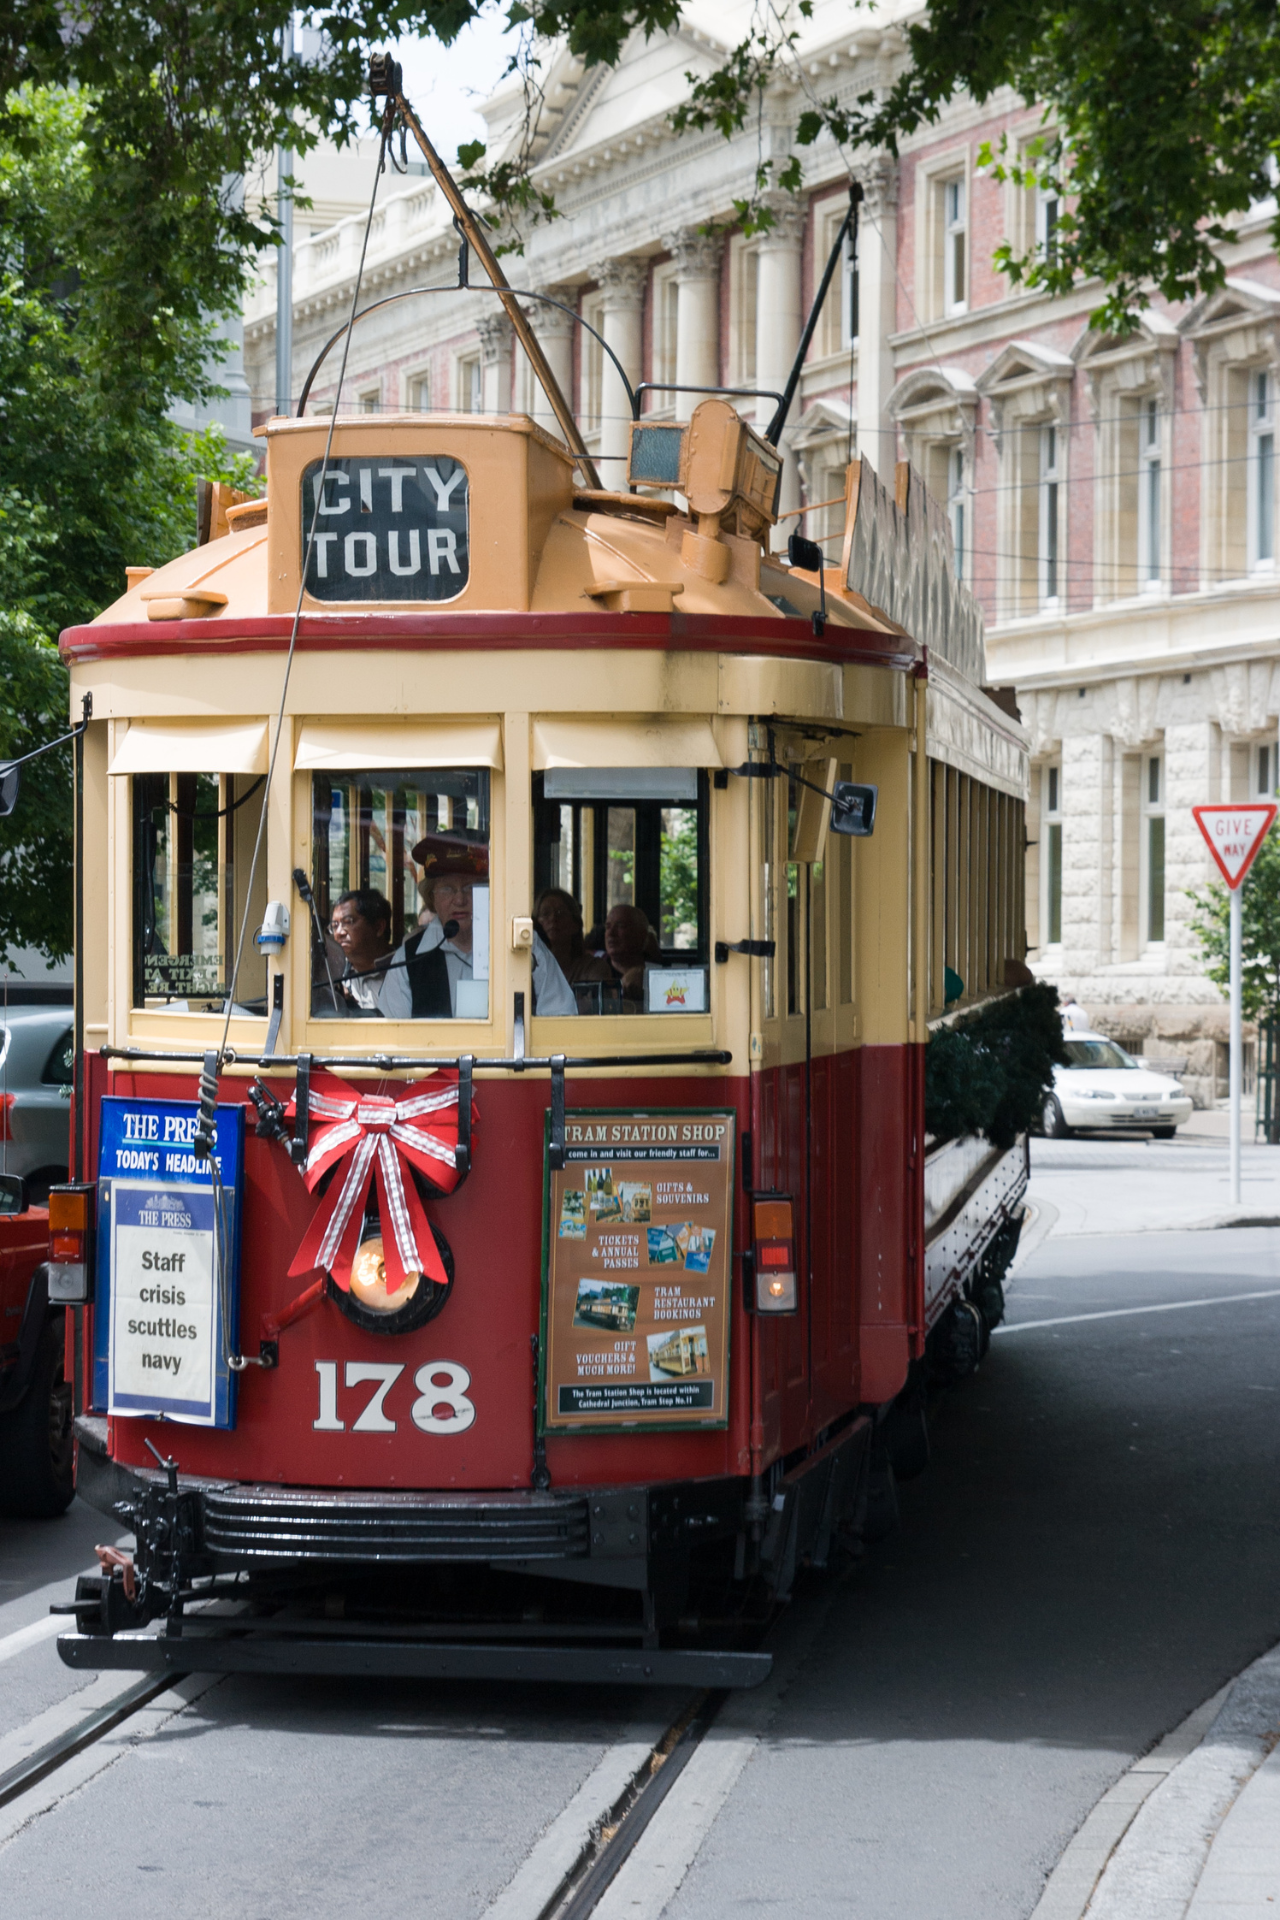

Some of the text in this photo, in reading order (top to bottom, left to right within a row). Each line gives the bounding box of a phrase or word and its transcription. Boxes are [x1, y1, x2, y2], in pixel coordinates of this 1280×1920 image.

[313, 467, 466, 515] CITY
[307, 528, 461, 578] TOUR
[1215, 818, 1252, 836] GIVE
[1223, 843, 1246, 857] WAY
[123, 1113, 218, 1147] THE PRE
[565, 1124, 725, 1142] TRAM STATION SHOP
[115, 1149, 159, 1172] TODAY'S
[568, 1150, 588, 1158] come
[590, 1148, 598, 1158] in
[599, 1149, 614, 1158] and
[616, 1148, 632, 1158] visit
[634, 1150, 647, 1158] our
[649, 1148, 677, 1160] friendly
[679, 1148, 696, 1157] staff
[656, 1182, 693, 1193] GIFTS &
[656, 1193, 710, 1204] SOUVENIRS
[138, 1210, 192, 1228] THE PRESS
[598, 1235, 640, 1246] TICKETS
[591, 1247, 639, 1258] & ANNUAL
[142, 1251, 185, 1272] Staff
[603, 1258, 639, 1269] PASSES
[140, 1284, 186, 1305] crisis
[654, 1286, 681, 1297] TRAM
[654, 1297, 715, 1309] RESTAURANT
[653, 1308, 702, 1321] BOOKINGS
[128, 1317, 197, 1339] scuttles
[614, 1341, 636, 1352] GIFT
[142, 1353, 182, 1375] navy
[576, 1352, 636, 1365] VOUCHERS &
[577, 1363, 636, 1376] MUCH MORE!
[312, 1359, 477, 1435] 178
[572, 1384, 700, 1398] The Tram Station Shop is located within
[578, 1399, 610, 1408] Cathedral
[611, 1398, 640, 1409] Junction,
[641, 1397, 657, 1406] Tram
[659, 1396, 674, 1406] Stop
